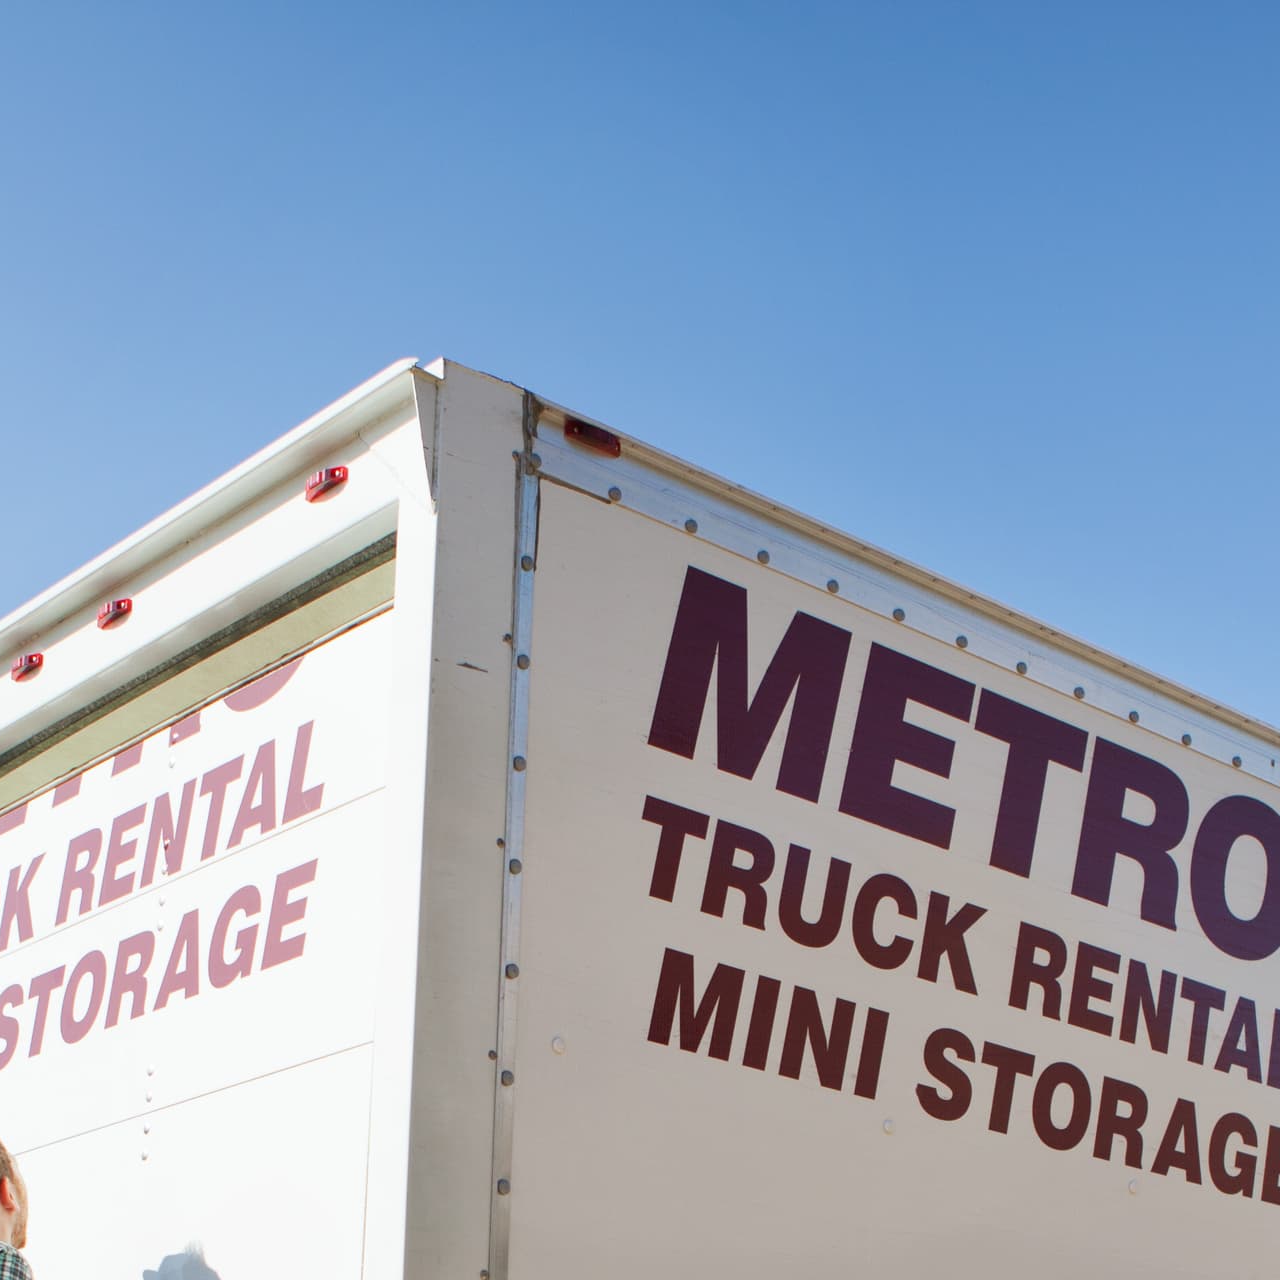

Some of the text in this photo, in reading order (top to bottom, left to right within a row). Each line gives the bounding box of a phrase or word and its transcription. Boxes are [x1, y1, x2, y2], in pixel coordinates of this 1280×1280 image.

[54, 720, 325, 926] RENTAL
[642, 794, 988, 997] TRUCK
[646, 946, 890, 1100] MINI
